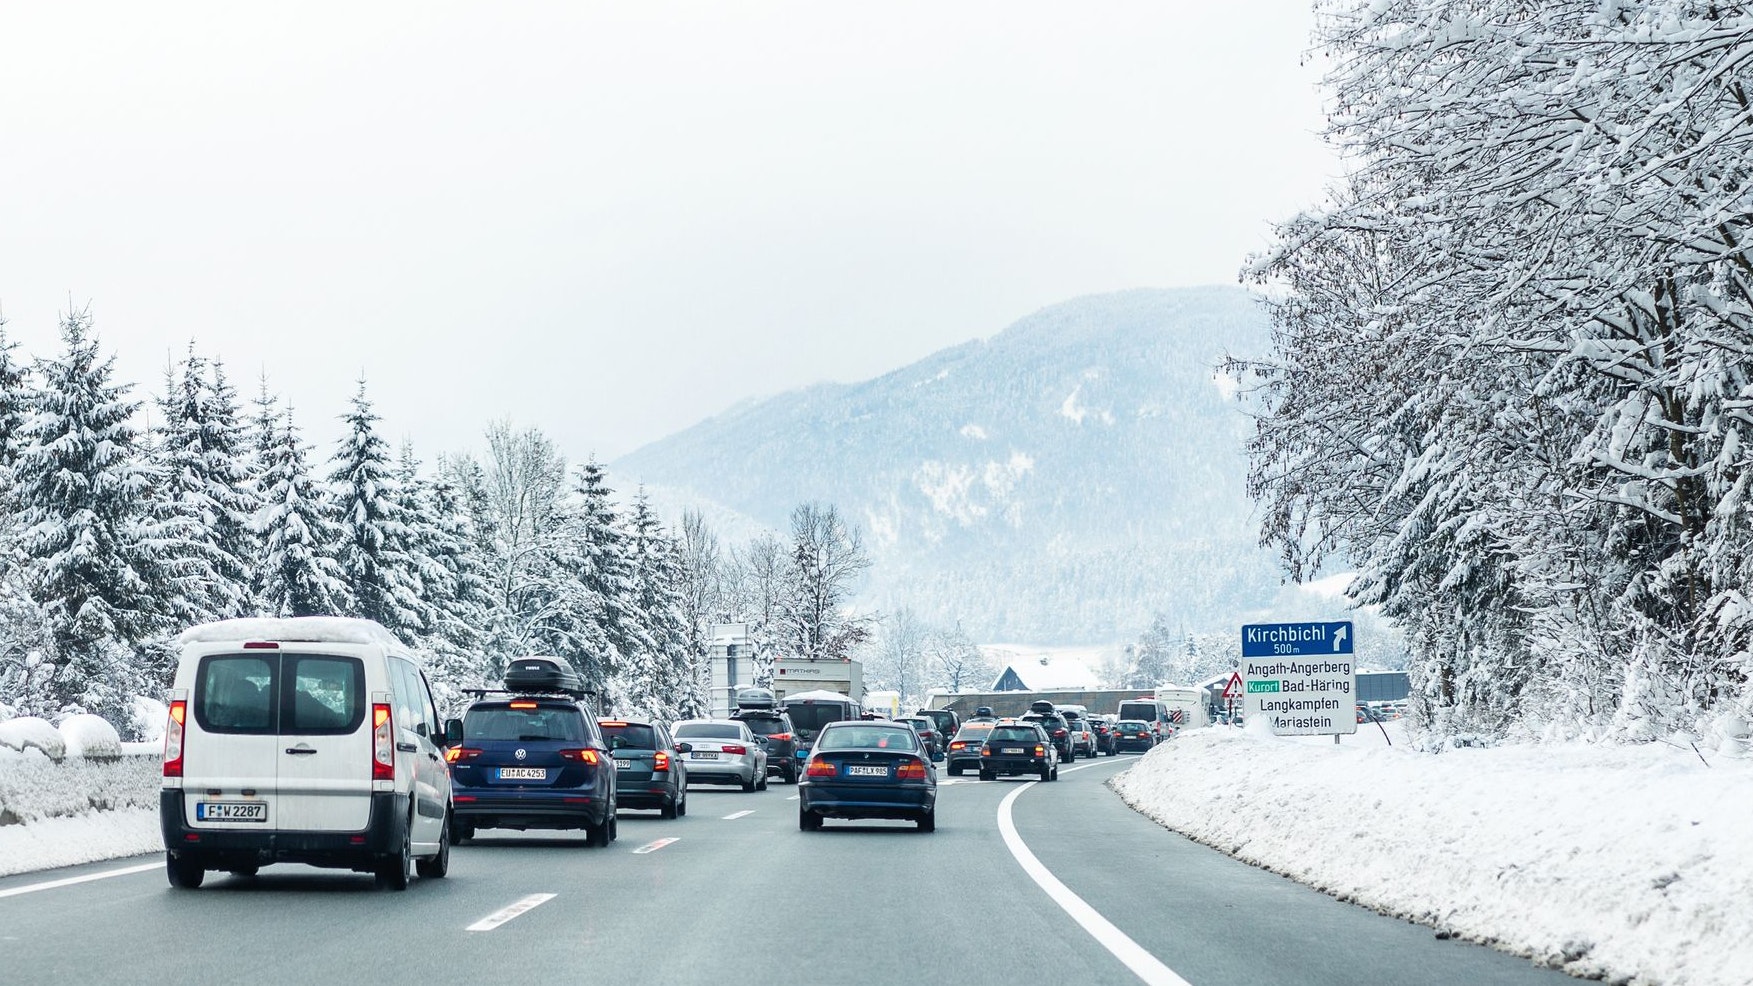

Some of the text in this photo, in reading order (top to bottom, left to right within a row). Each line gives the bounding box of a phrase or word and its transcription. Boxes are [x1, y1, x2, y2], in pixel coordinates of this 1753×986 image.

[1247, 625, 1325, 642] Kirchbichl
[1247, 661, 1350, 677] Angath-Angerberg
[1248, 682, 1278, 692] Kurort
[1260, 697, 1339, 713] Langkampfen
[209, 805, 216, 816] F
[233, 806, 261, 817] 2287
